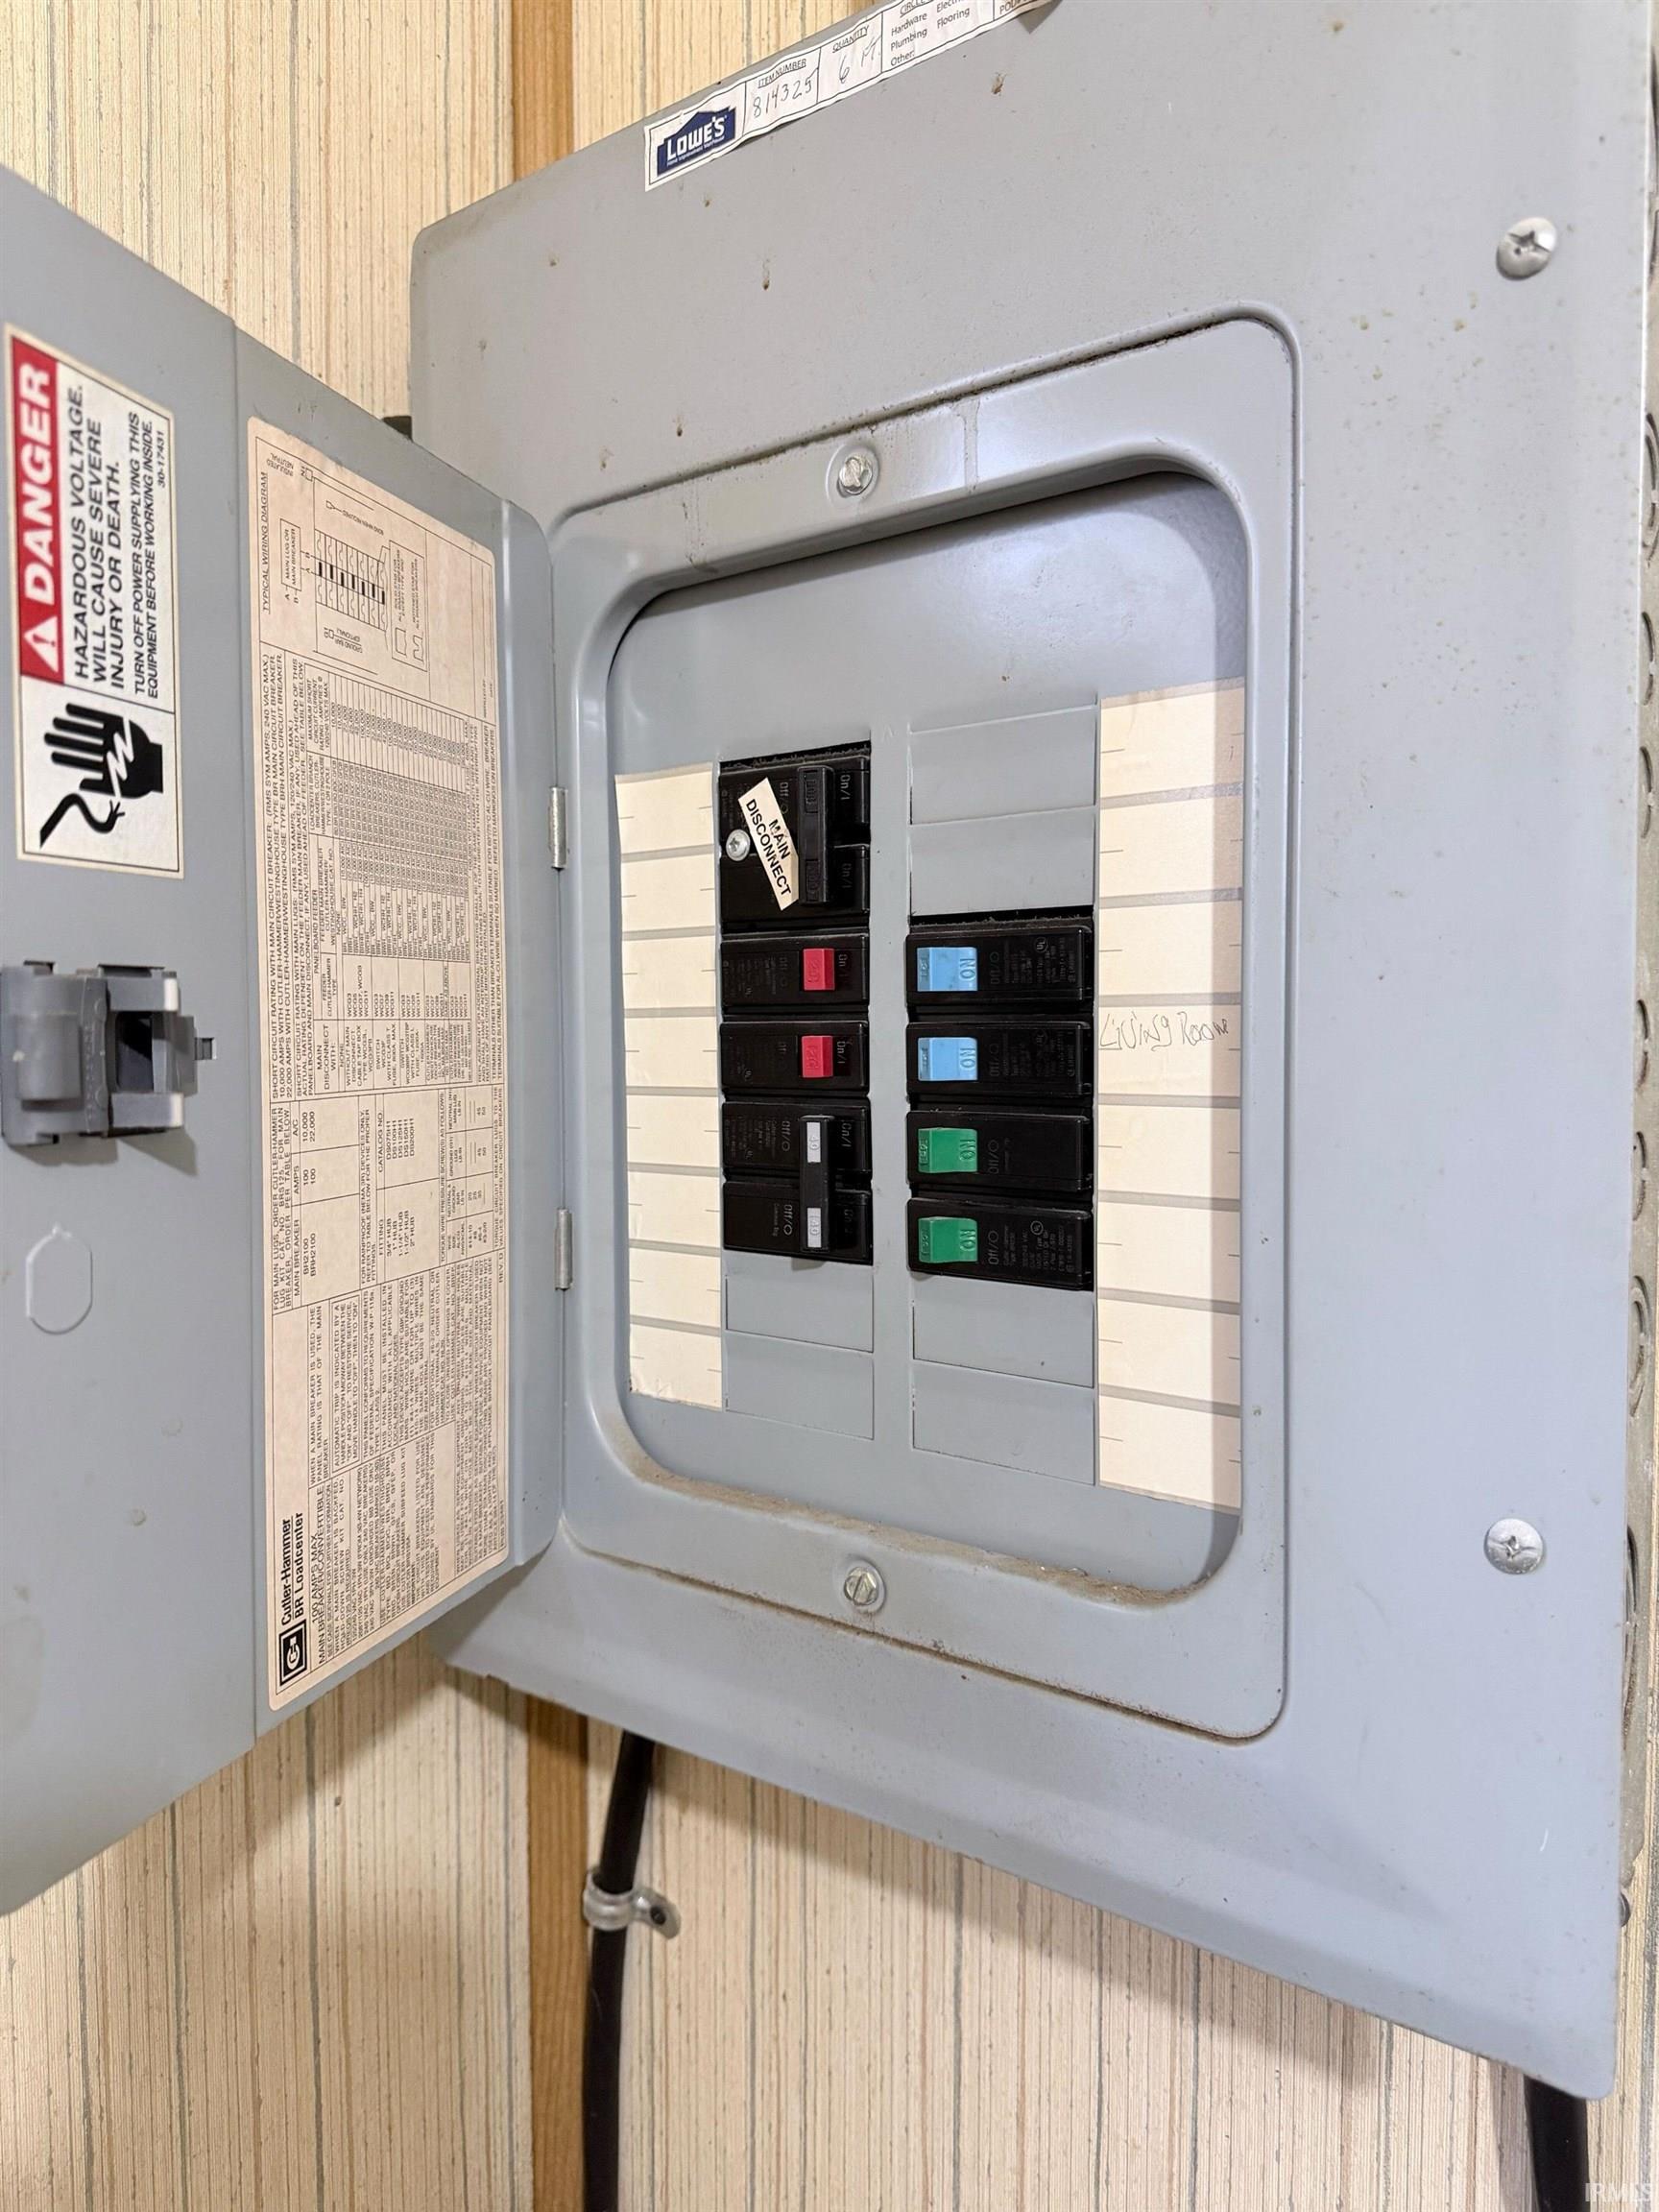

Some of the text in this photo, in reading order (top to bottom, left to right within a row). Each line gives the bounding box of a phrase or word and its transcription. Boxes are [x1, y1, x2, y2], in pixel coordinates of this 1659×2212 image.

[832, 25, 870, 52] QUANTITY
[890, 8, 971, 52] Plumbing Flooring
[891, 12, 927, 36] Hardware
[757, 59, 806, 87] ITEM NUMBER
[890, 51, 915, 66] Other:
[667, 116, 725, 161] LOWE'S
[156, 430, 166, 488] 30-17431
[19, 363, 55, 605] DANGER
[67, 386, 88, 679] HAZARDOUS VOLTAGE.
[86, 419, 107, 683] WILL CAUSE SEVERE
[129, 412, 144, 694] TURN OFF POWER SUPPLYING THIS
[106, 462, 124, 688] INJURY OR DEATH.
[142, 421, 157, 699] EQUIPMENT BEFORE WORKING INSIDE.
[273, 780, 278, 796] BR
[746, 799, 791, 896] DISCONNECT
[769, 819, 791, 860] MAIN
[959, 958, 976, 980] ON
[959, 1047, 976, 1070] ON
[959, 1140, 976, 1160] ON
[959, 1229, 976, 1252] ON
[310, 1361, 316, 1371] IS
[317, 1356, 322, 1369] OF
[317, 1401, 323, 1409] IS
[281, 1519, 292, 1625] Cutler-Hammer
[295, 1512, 304, 1619] BR Loadcenter
[316, 1486, 325, 1631] BREAKER/CONVERTIBLE
